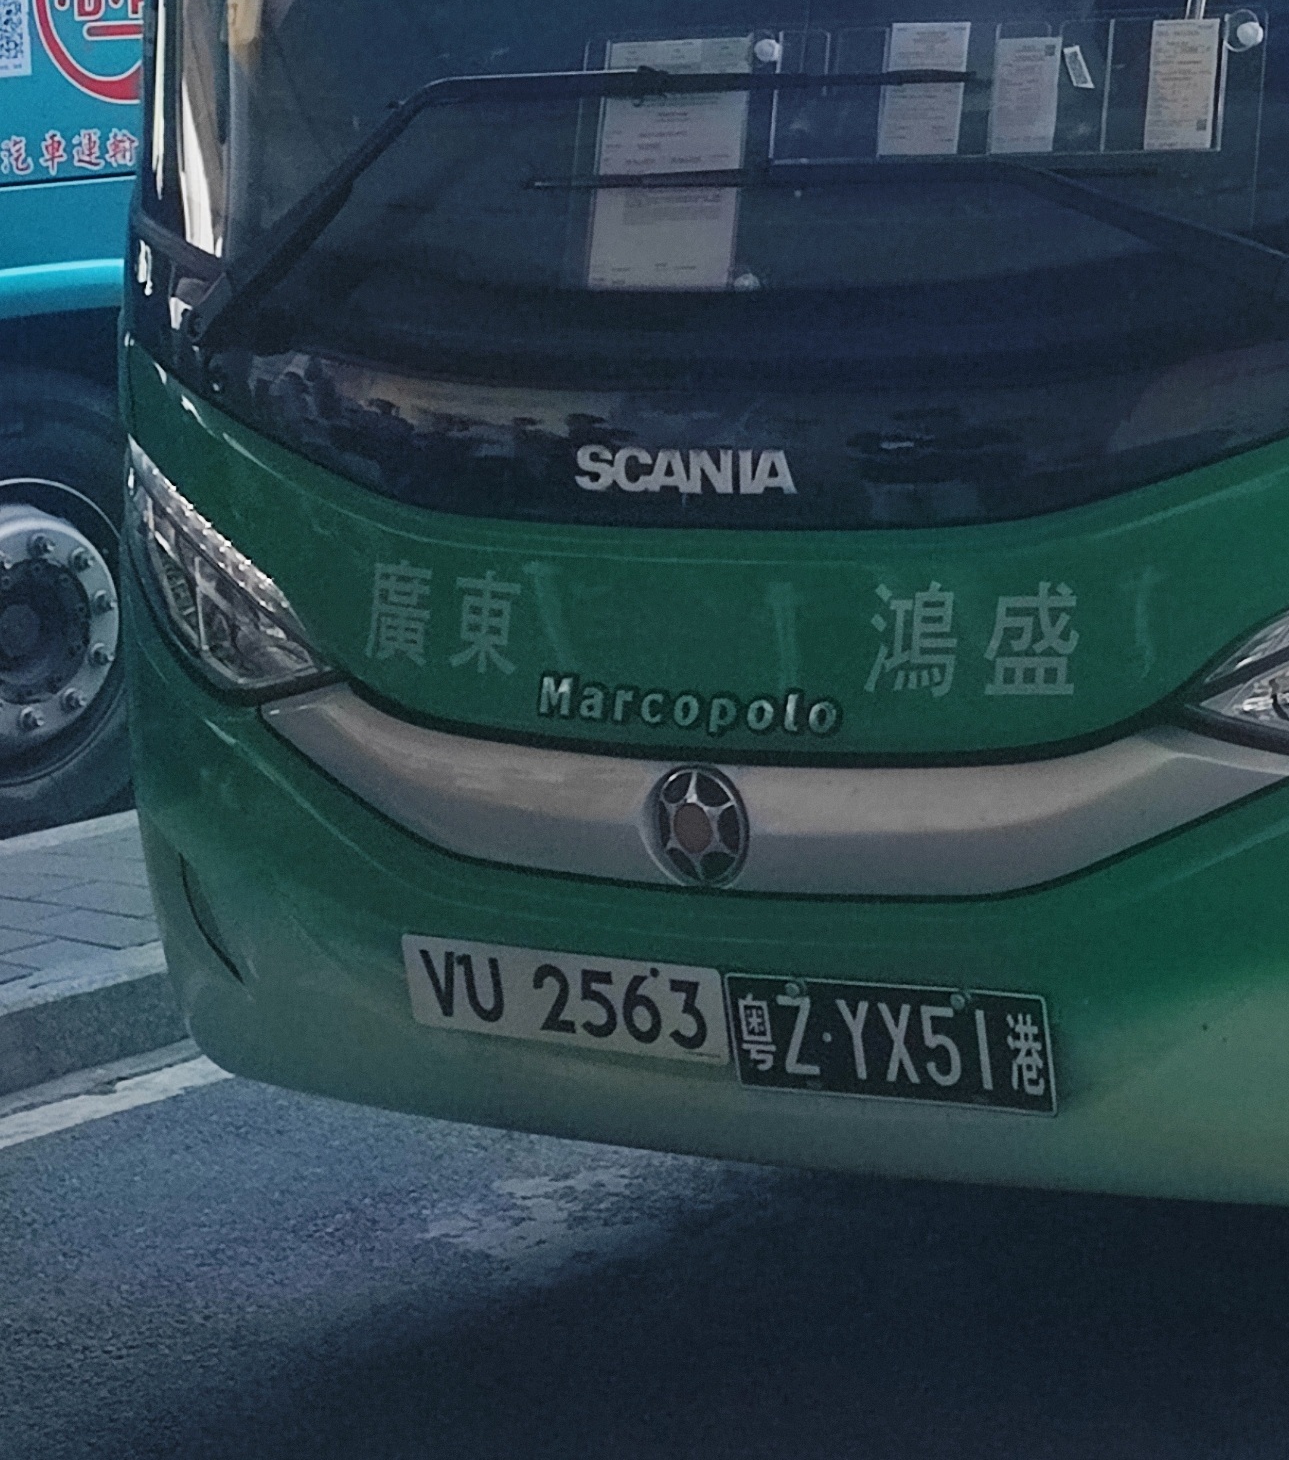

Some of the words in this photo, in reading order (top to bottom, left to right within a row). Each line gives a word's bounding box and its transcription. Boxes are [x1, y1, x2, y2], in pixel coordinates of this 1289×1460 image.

[574, 444, 799, 495] SCANIA
[364, 558, 523, 675] 廣東
[863, 580, 1081, 698] 鴻盛
[536, 672, 839, 737] Marcopolo
[418, 948, 506, 1024] VU
[531, 964, 709, 1051] 2563
